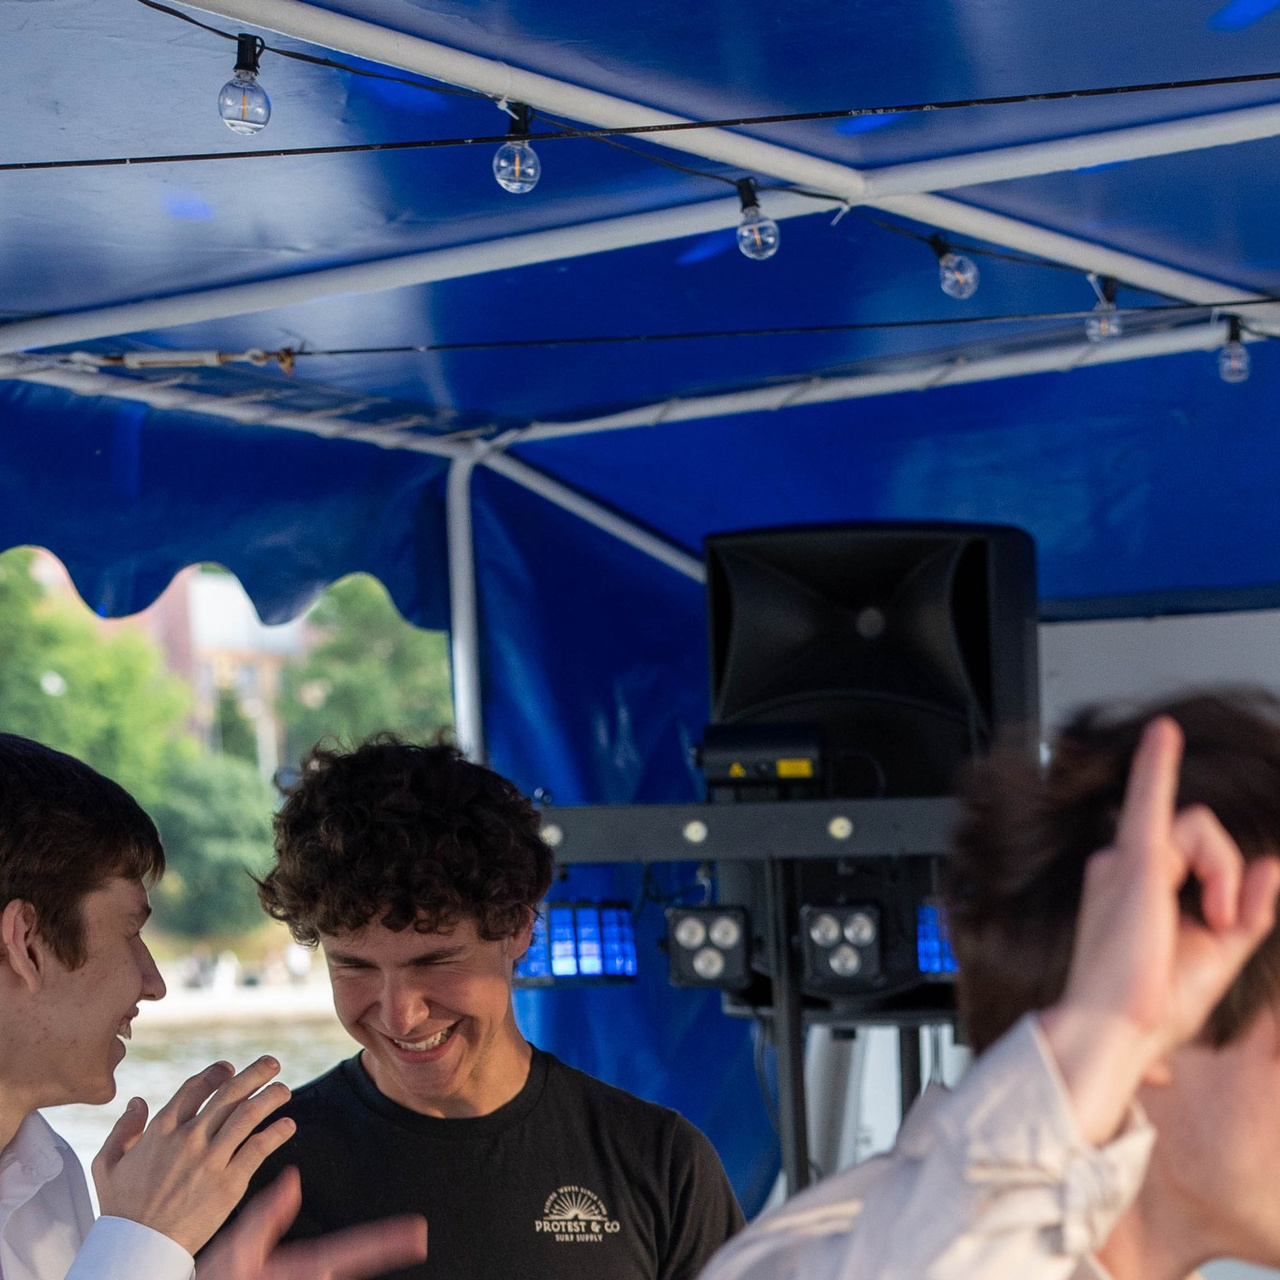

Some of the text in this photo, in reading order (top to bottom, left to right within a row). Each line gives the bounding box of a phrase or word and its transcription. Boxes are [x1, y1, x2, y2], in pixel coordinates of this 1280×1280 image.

[534, 1220, 620, 1233] PROTEST & CO
[555, 1233, 603, 1242] SURF SUPPLY
